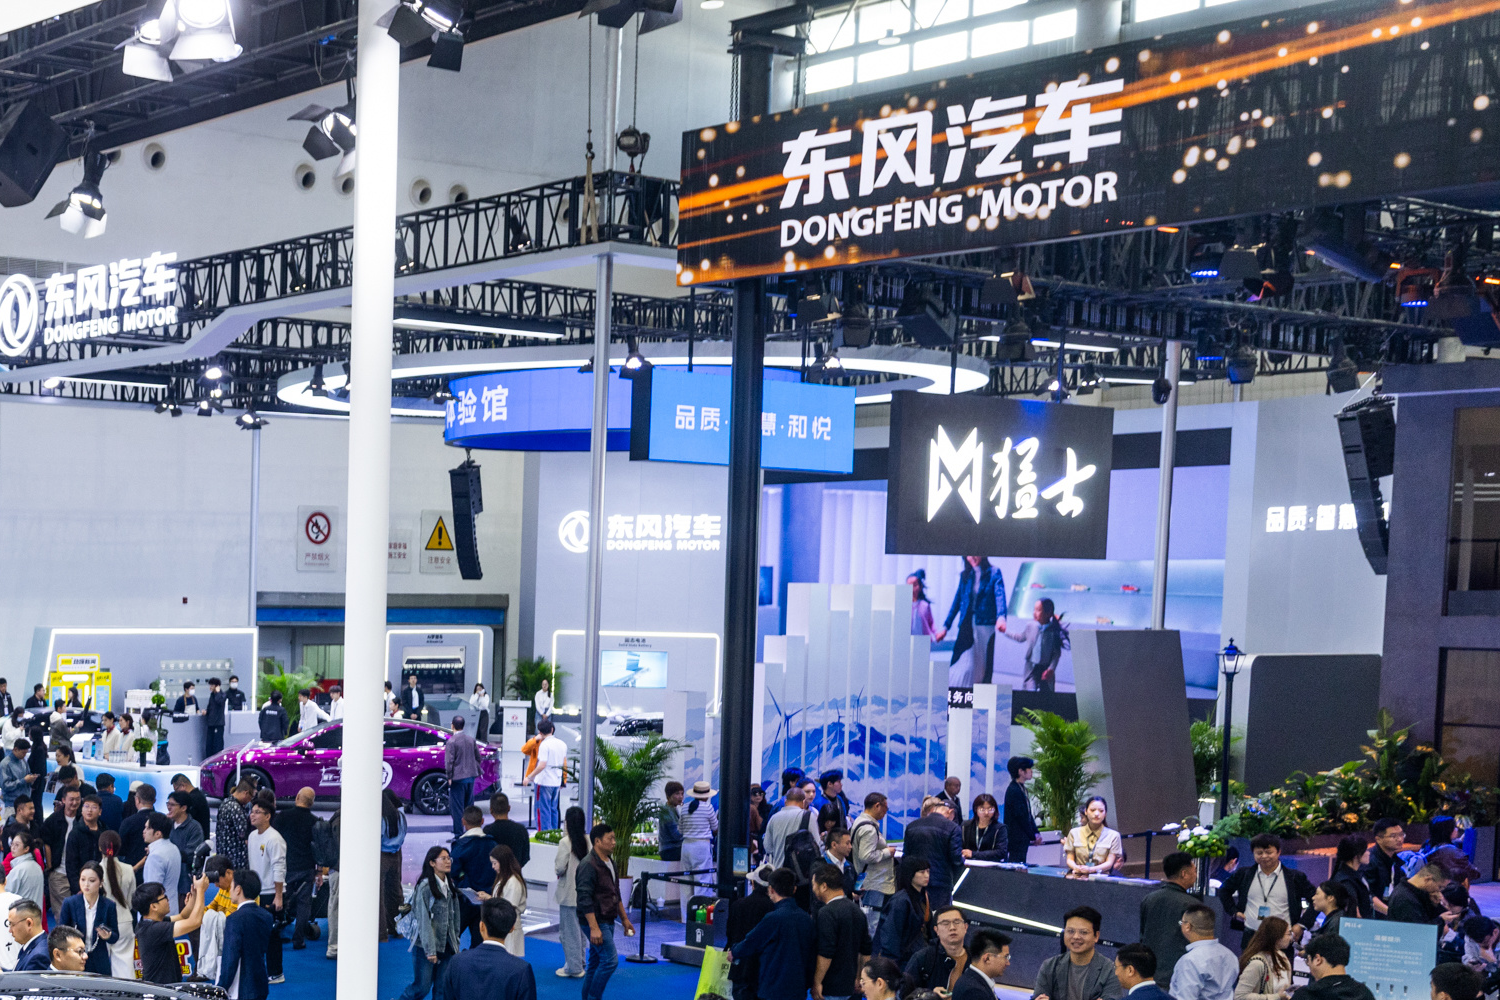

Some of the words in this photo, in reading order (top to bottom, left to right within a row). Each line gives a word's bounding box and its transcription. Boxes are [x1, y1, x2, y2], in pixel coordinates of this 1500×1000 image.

[779, 78, 1125, 210] 东风汽车
[780, 193, 963, 248] DONGFENG
[979, 171, 1118, 220] MOTOR
[44, 251, 177, 321] 东风汽车
[43, 315, 119, 345] DONGFENG
[122, 305, 177, 332] MOTOR
[675, 404, 832, 441] 品质·慧·和悦
[989, 436, 1097, 519] 猛士
[606, 514, 722, 539] 东风汽车
[606, 540, 673, 551] DONGFENG
[676, 540, 721, 551] MOTOR
[304, 552, 330, 561] 严禁烟火
[427, 556, 452, 565] 注意安全
